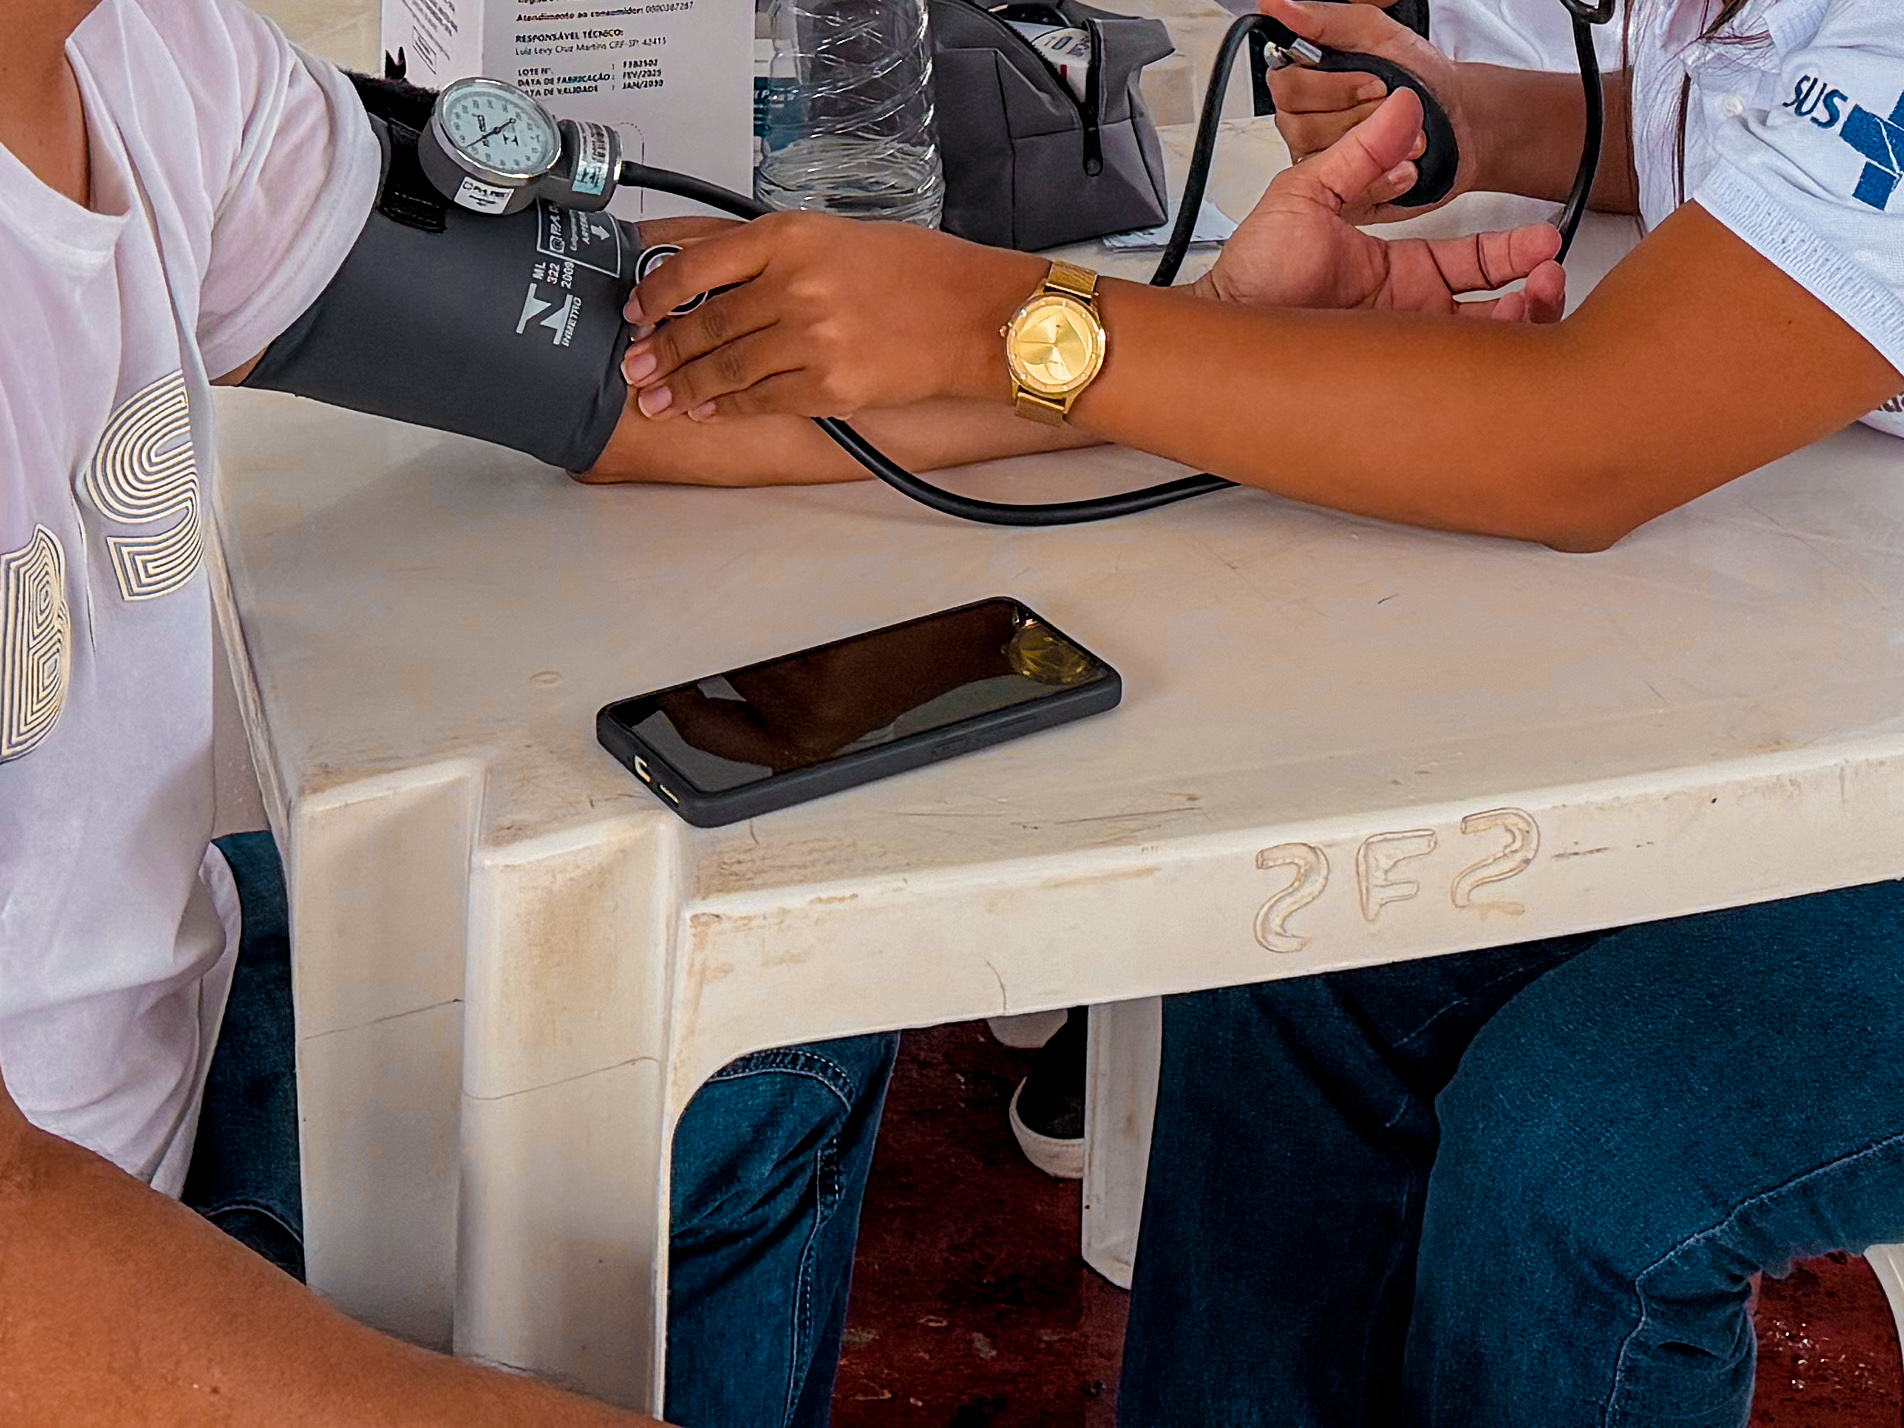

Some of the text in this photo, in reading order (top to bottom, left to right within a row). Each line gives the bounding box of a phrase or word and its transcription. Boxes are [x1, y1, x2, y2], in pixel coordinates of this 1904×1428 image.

[522, 88, 541, 97] ATA
[1782, 74, 1848, 130] SUS
[532, 262, 546, 280] ML
[547, 263, 561, 285] 322
[561, 297, 582, 347] INMETRO
